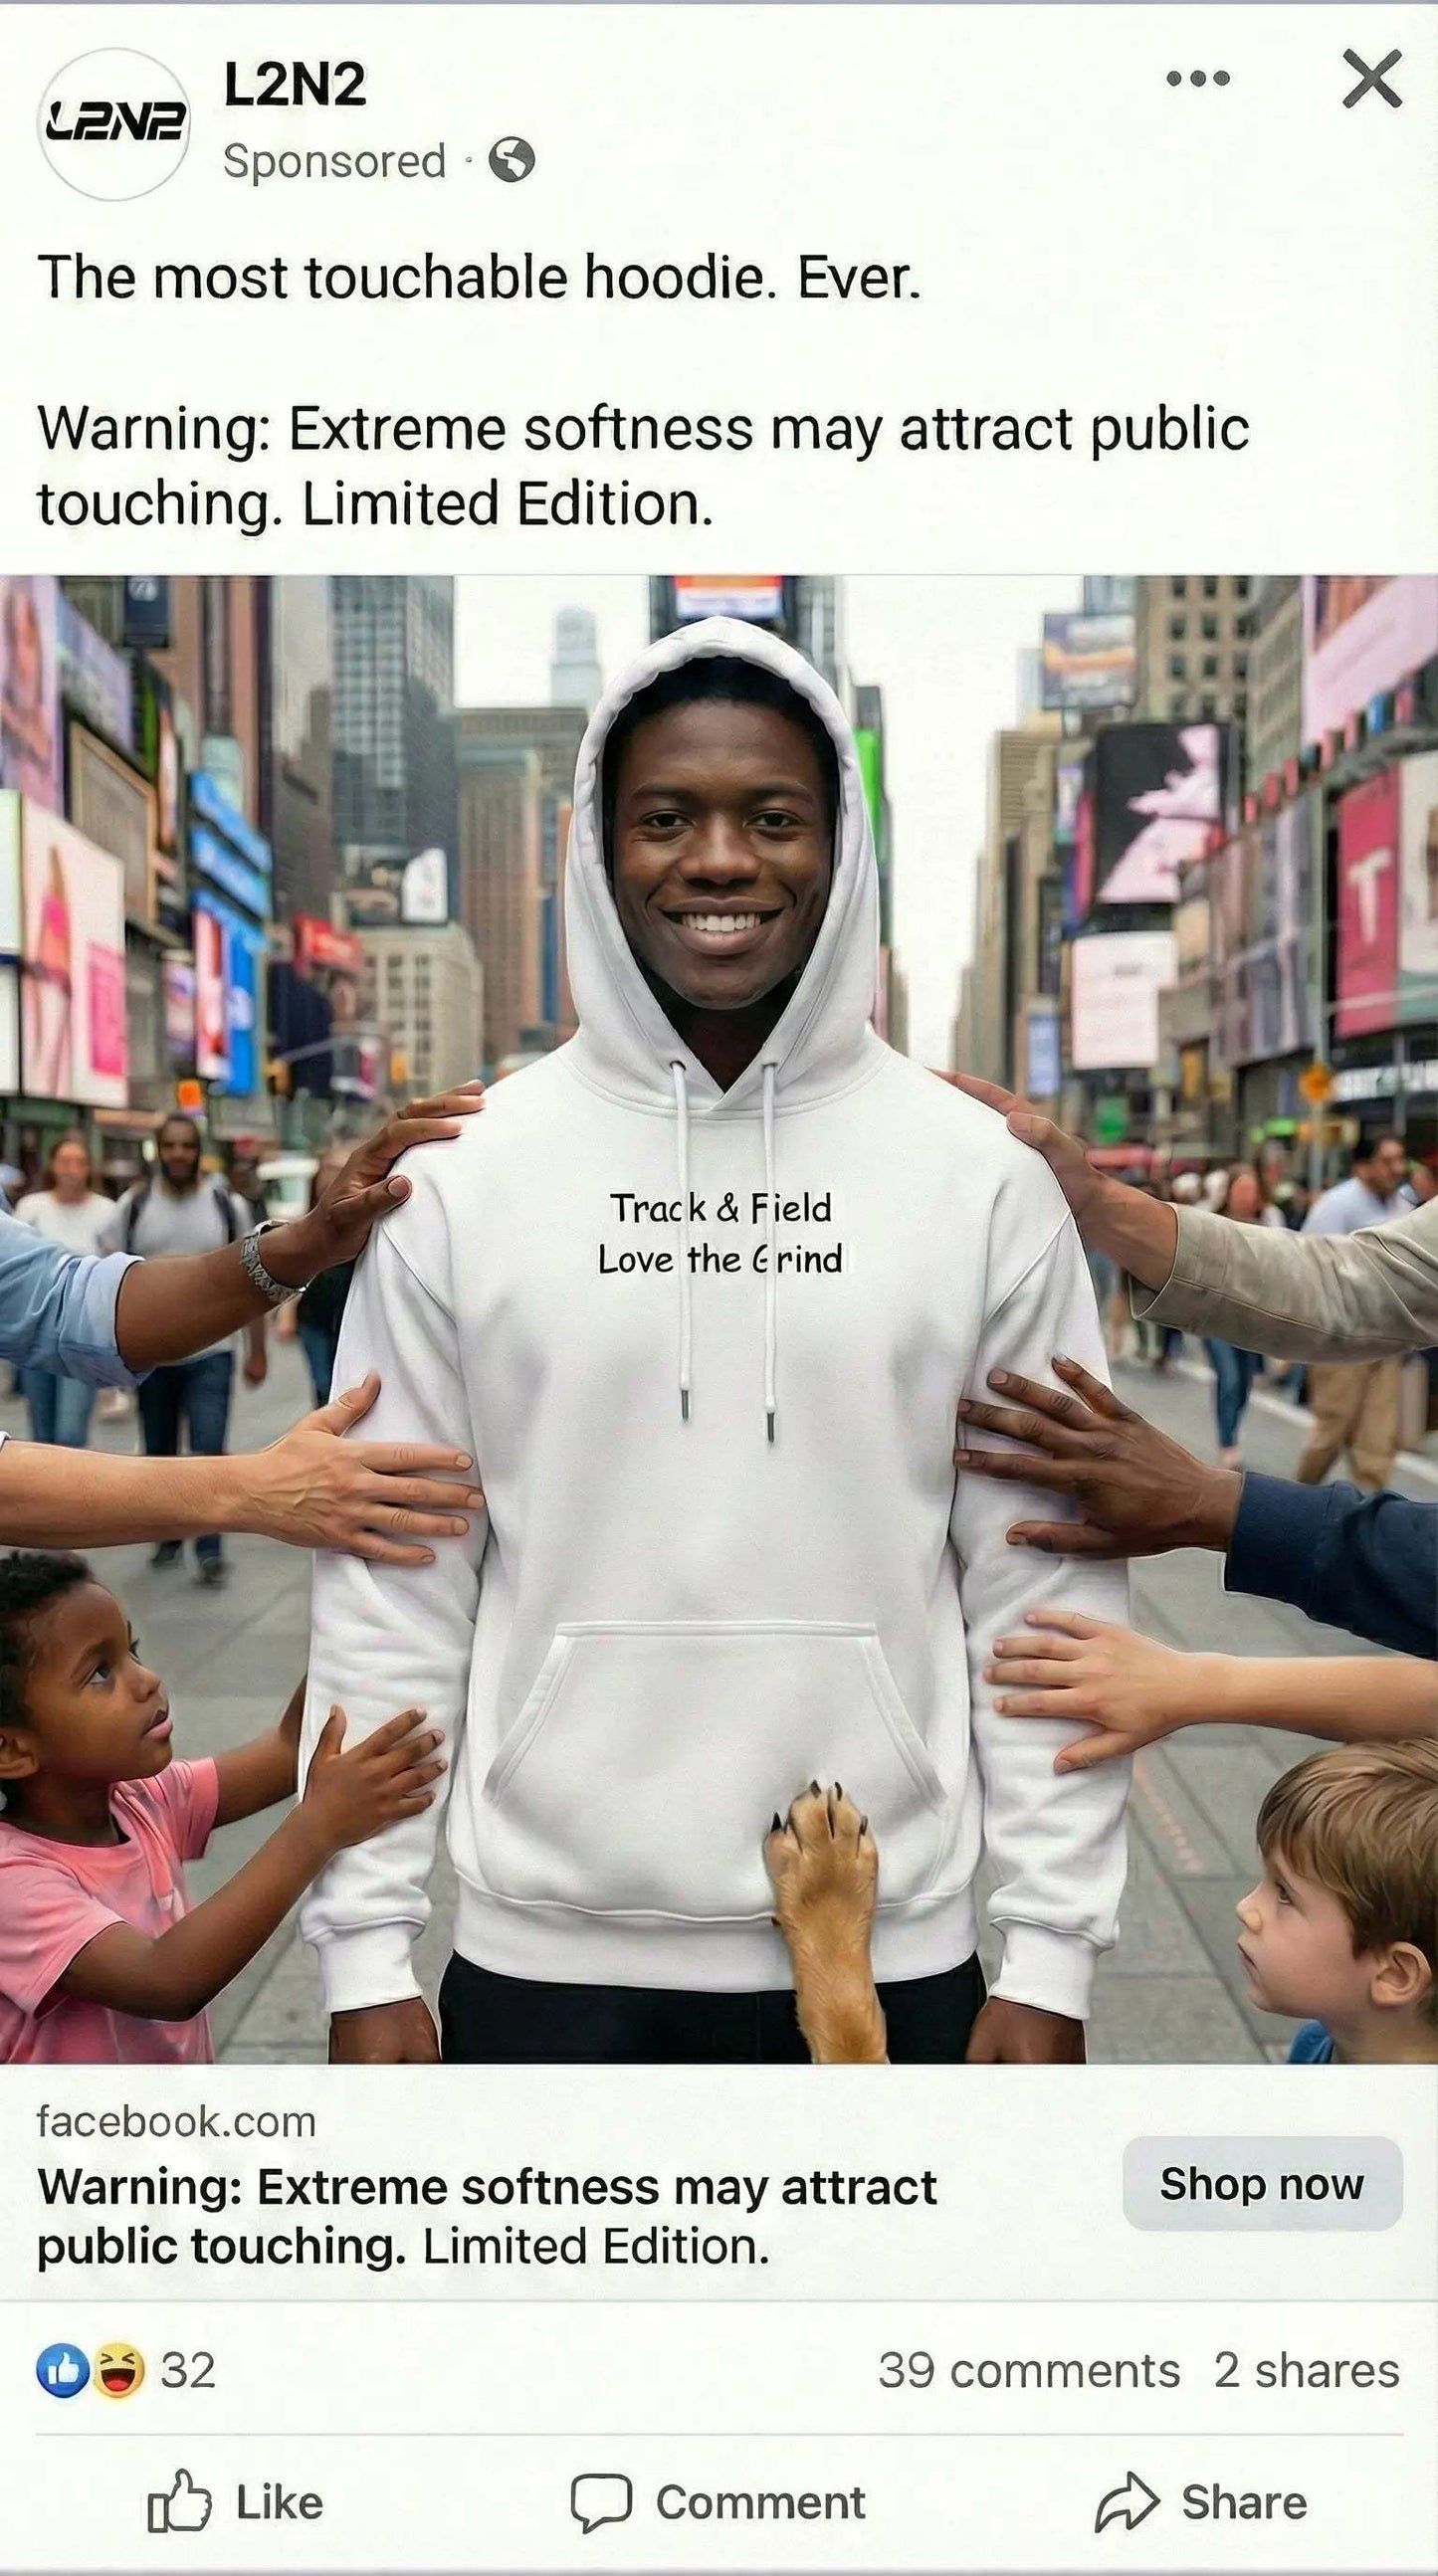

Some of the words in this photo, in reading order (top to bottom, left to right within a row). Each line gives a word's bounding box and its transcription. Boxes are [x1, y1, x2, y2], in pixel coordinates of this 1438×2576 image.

[610, 1191, 707, 1224] Track
[717, 1191, 739, 1223] &
[752, 1191, 832, 1225] Field
[599, 1243, 674, 1275] Love
[688, 1242, 742, 1274] the
[753, 1242, 842, 1274] Grind
